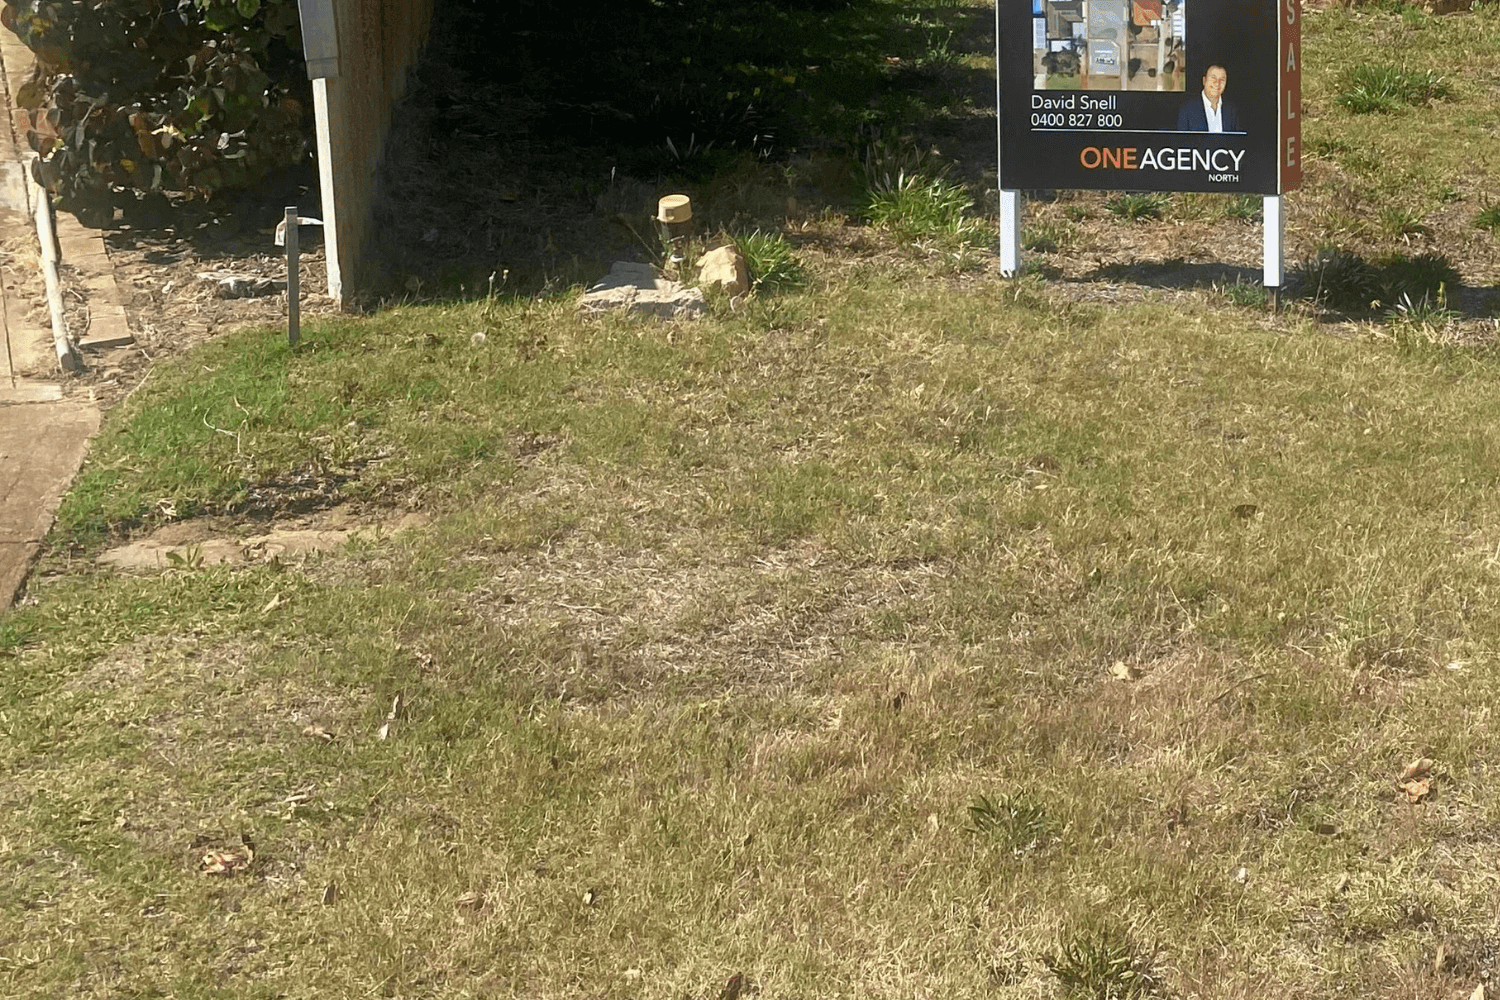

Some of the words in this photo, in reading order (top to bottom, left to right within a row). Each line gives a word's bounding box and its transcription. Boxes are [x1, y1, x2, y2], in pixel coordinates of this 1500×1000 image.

[1031, 94, 1075, 110] David
[1080, 95, 1116, 110] Snell
[1030, 113, 1065, 127] 0400
[1068, 113, 1093, 127] 827
[1097, 113, 1123, 128] 800
[1208, 173, 1240, 183] NORTH
